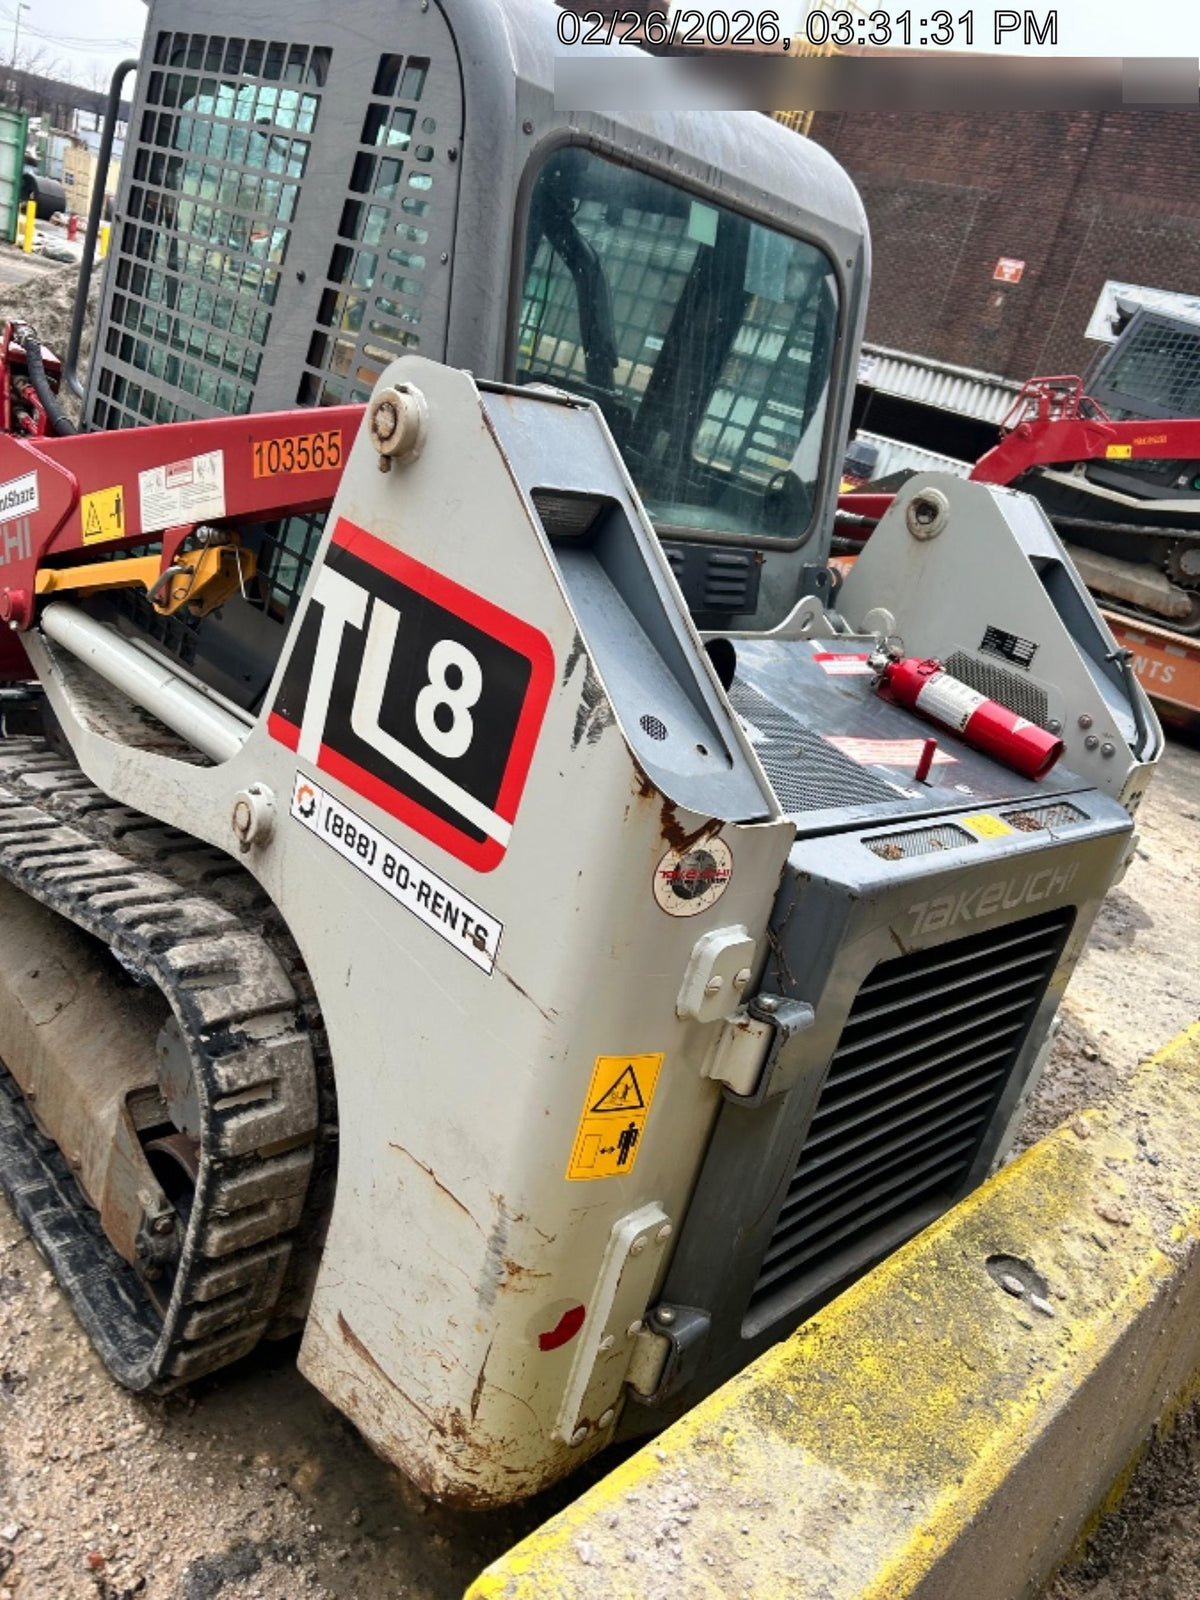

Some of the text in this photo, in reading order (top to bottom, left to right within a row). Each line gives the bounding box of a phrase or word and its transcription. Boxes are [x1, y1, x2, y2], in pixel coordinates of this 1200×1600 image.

[255, 432, 340, 475] 103565
[0, 517, 32, 565] HI
[297, 564, 513, 850] TL8
[324, 807, 489, 951] (888) 80-RENTS
[908, 862, 1081, 937] TAKEUCHI
